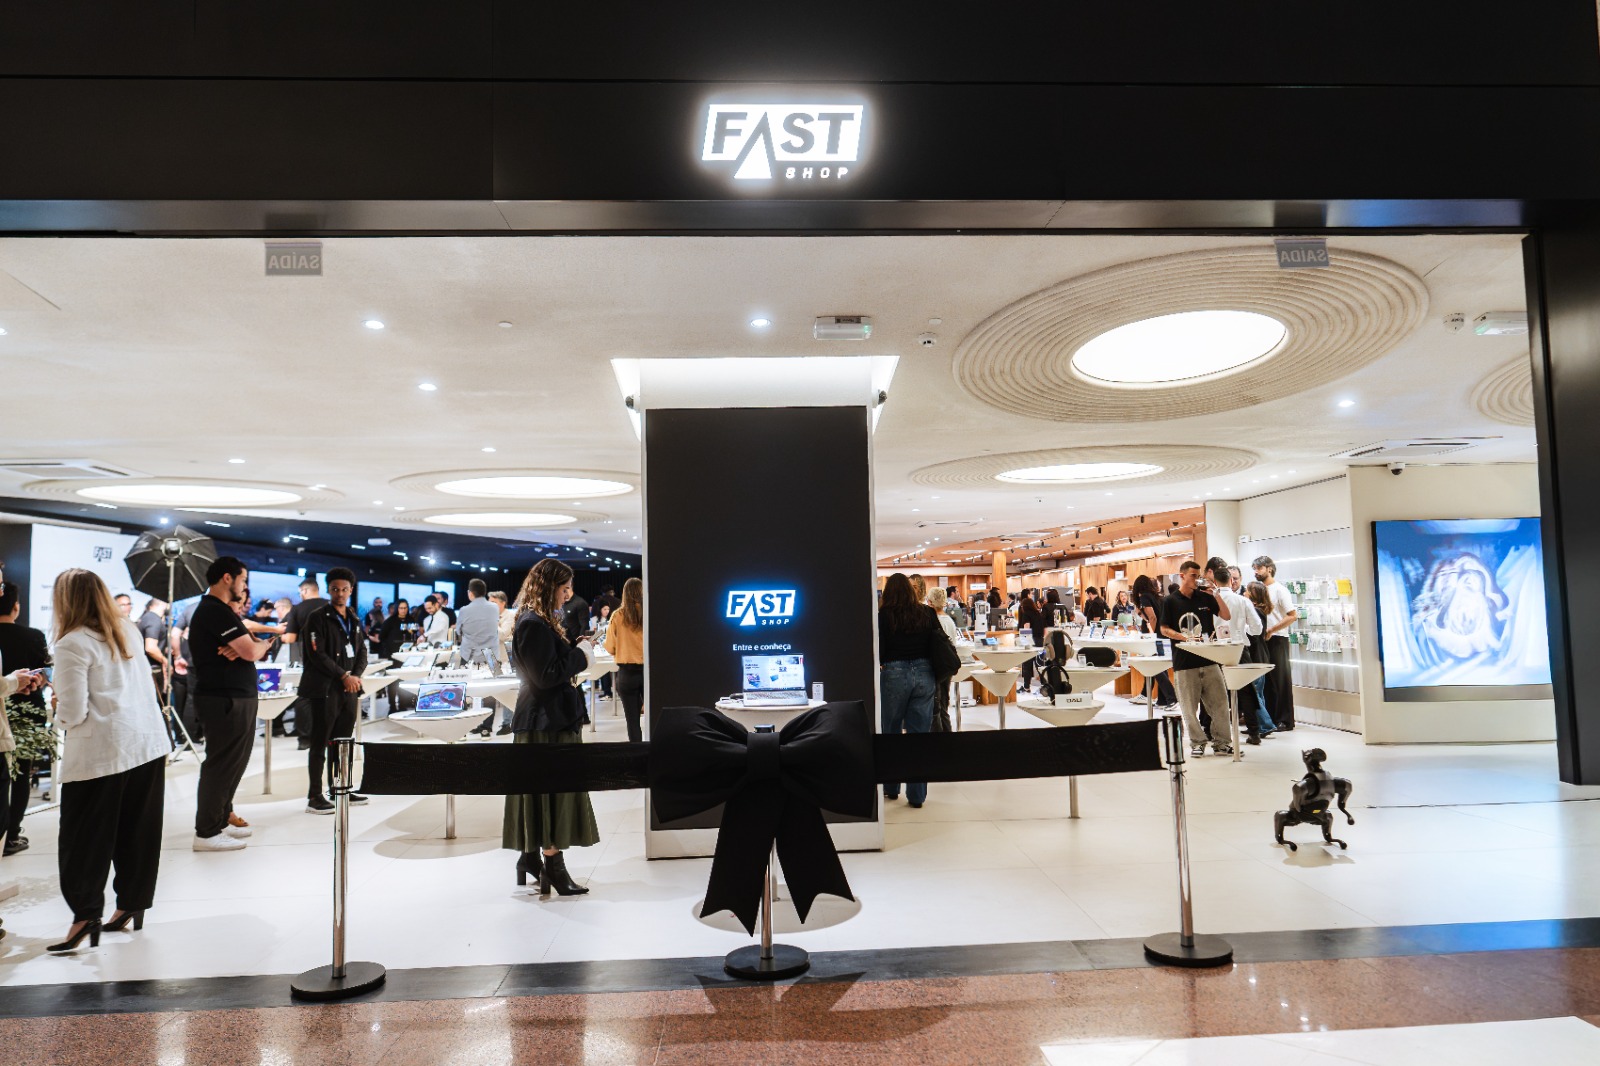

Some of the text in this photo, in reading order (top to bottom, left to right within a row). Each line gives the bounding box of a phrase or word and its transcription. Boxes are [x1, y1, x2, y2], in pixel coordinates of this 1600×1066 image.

[710, 110, 856, 174] FAST
[785, 167, 849, 179] SHOP
[729, 592, 793, 622] FAST
[761, 618, 790, 626] SHOP
[760, 643, 791, 652] conheça
